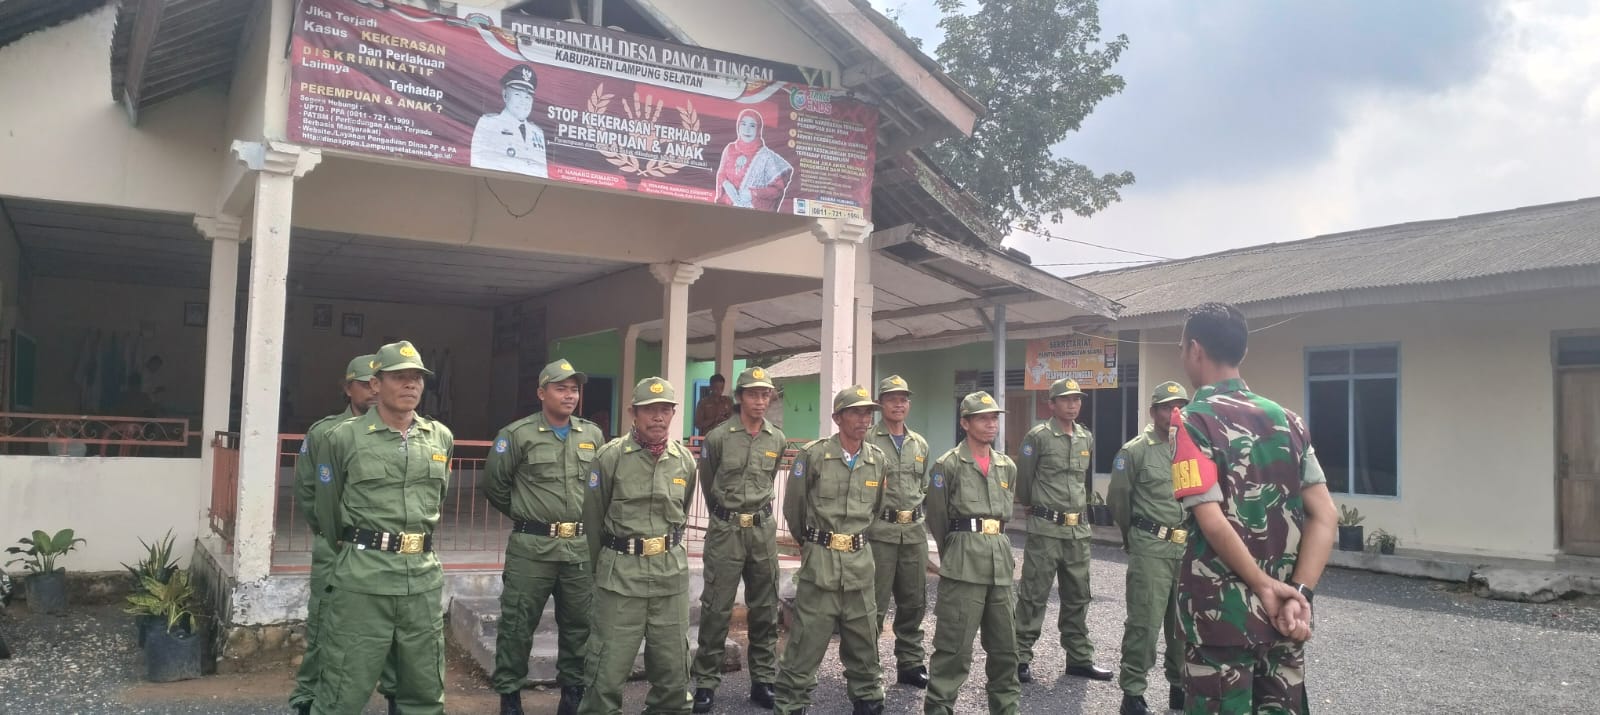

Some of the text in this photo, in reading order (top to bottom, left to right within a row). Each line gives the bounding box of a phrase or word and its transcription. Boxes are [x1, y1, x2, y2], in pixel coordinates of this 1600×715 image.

[306, 6, 378, 28] Jika Terjadi
[304, 20, 446, 56] Kasus KEKERASAN
[302, 57, 350, 74] Lainnya
[303, 46, 434, 76] DISKRIMINATIF
[358, 44, 445, 69] Dan Perlakuan
[618, 40, 656, 62] DESA
[662, 48, 708, 71] PANCA
[555, 49, 613, 70] KABUPATEN
[616, 61, 660, 80] LAMPUNG
[664, 71, 704, 88] SELATAN
[300, 82, 380, 103] PEREMPUAN
[384, 96, 393, 105] &
[398, 100, 432, 112] ANAK
[389, 80, 444, 100] Terhadap
[303, 118, 334, 128] Berbasis
[304, 104, 324, 112] UPTD
[374, 114, 386, 122] 721
[548, 105, 710, 146] STOP KEKERASAN TERHADAP
[384, 122, 402, 131] Anak
[408, 140, 428, 148] Dinas
[558, 123, 647, 151] PEREMPUAN
[652, 140, 661, 153] &
[666, 142, 704, 160] ANAK
